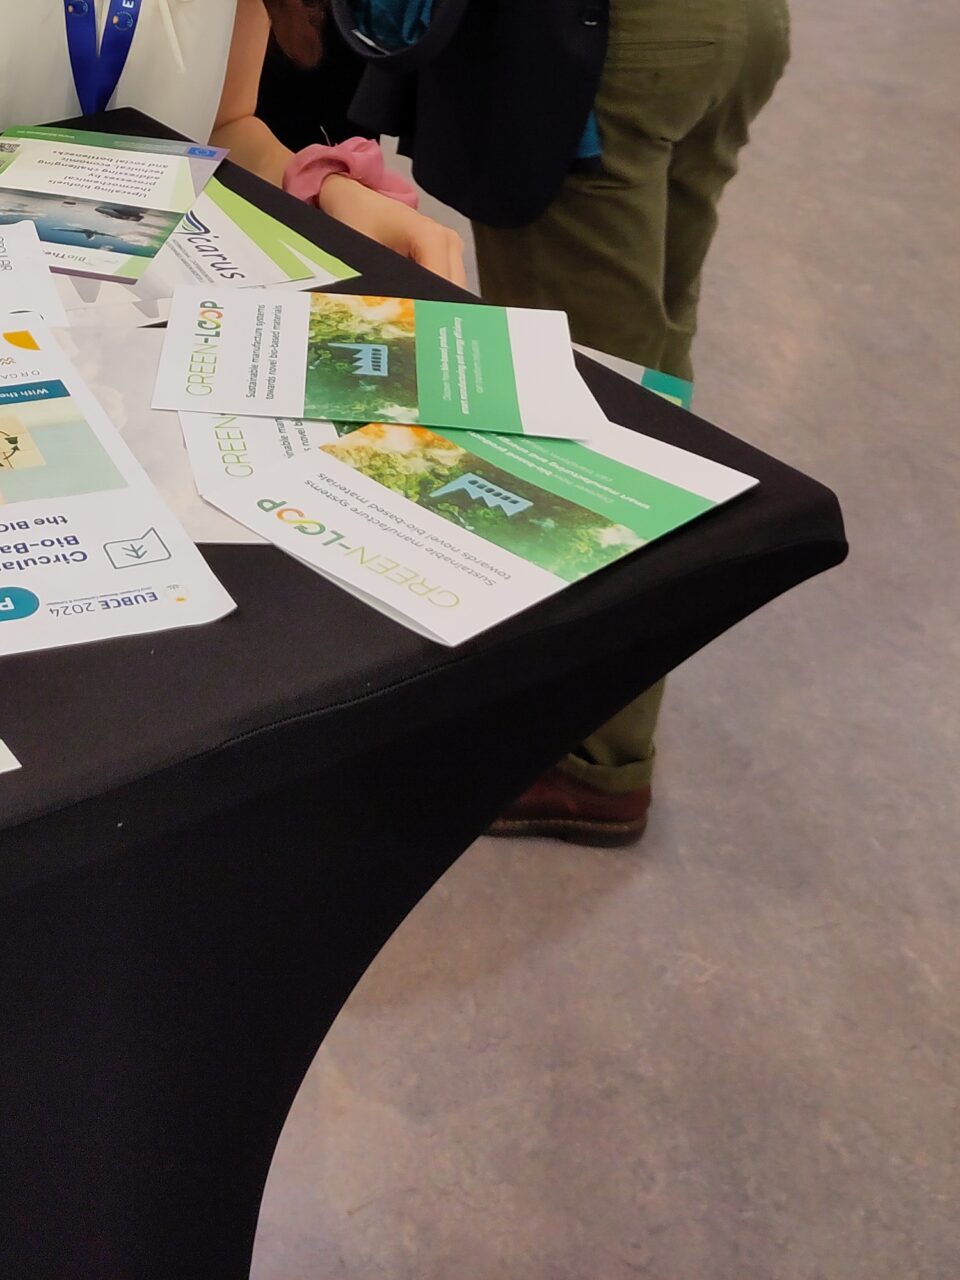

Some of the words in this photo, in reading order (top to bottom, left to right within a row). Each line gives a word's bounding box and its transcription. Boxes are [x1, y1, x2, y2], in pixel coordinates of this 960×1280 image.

[44, 249, 87, 263] BioThe
[254, 304, 266, 325] systems
[271, 305, 282, 329] materials
[186, 300, 223, 396] GREEN-LOOP
[249, 327, 263, 362] manufacture
[268, 331, 280, 358] bio-based
[267, 359, 277, 374] novel
[20, 388, 49, 397] With
[245, 364, 259, 397] Sustainable
[264, 376, 276, 399] towards
[0, 391, 19, 399] the
[215, 413, 253, 478] GREEN
[301, 478, 352, 508] systems
[313, 471, 370, 504] materials
[33, 515, 69, 527] the
[346, 504, 426, 549] manufacture
[365, 501, 427, 536] bio-based
[256, 497, 461, 610] GREEN-LOOP
[423, 532, 462, 555] novel
[420, 544, 498, 588] Sustainable
[456, 550, 513, 582] towards
[49, 600, 97, 619] 2024
[101, 591, 159, 611] EUBCE
